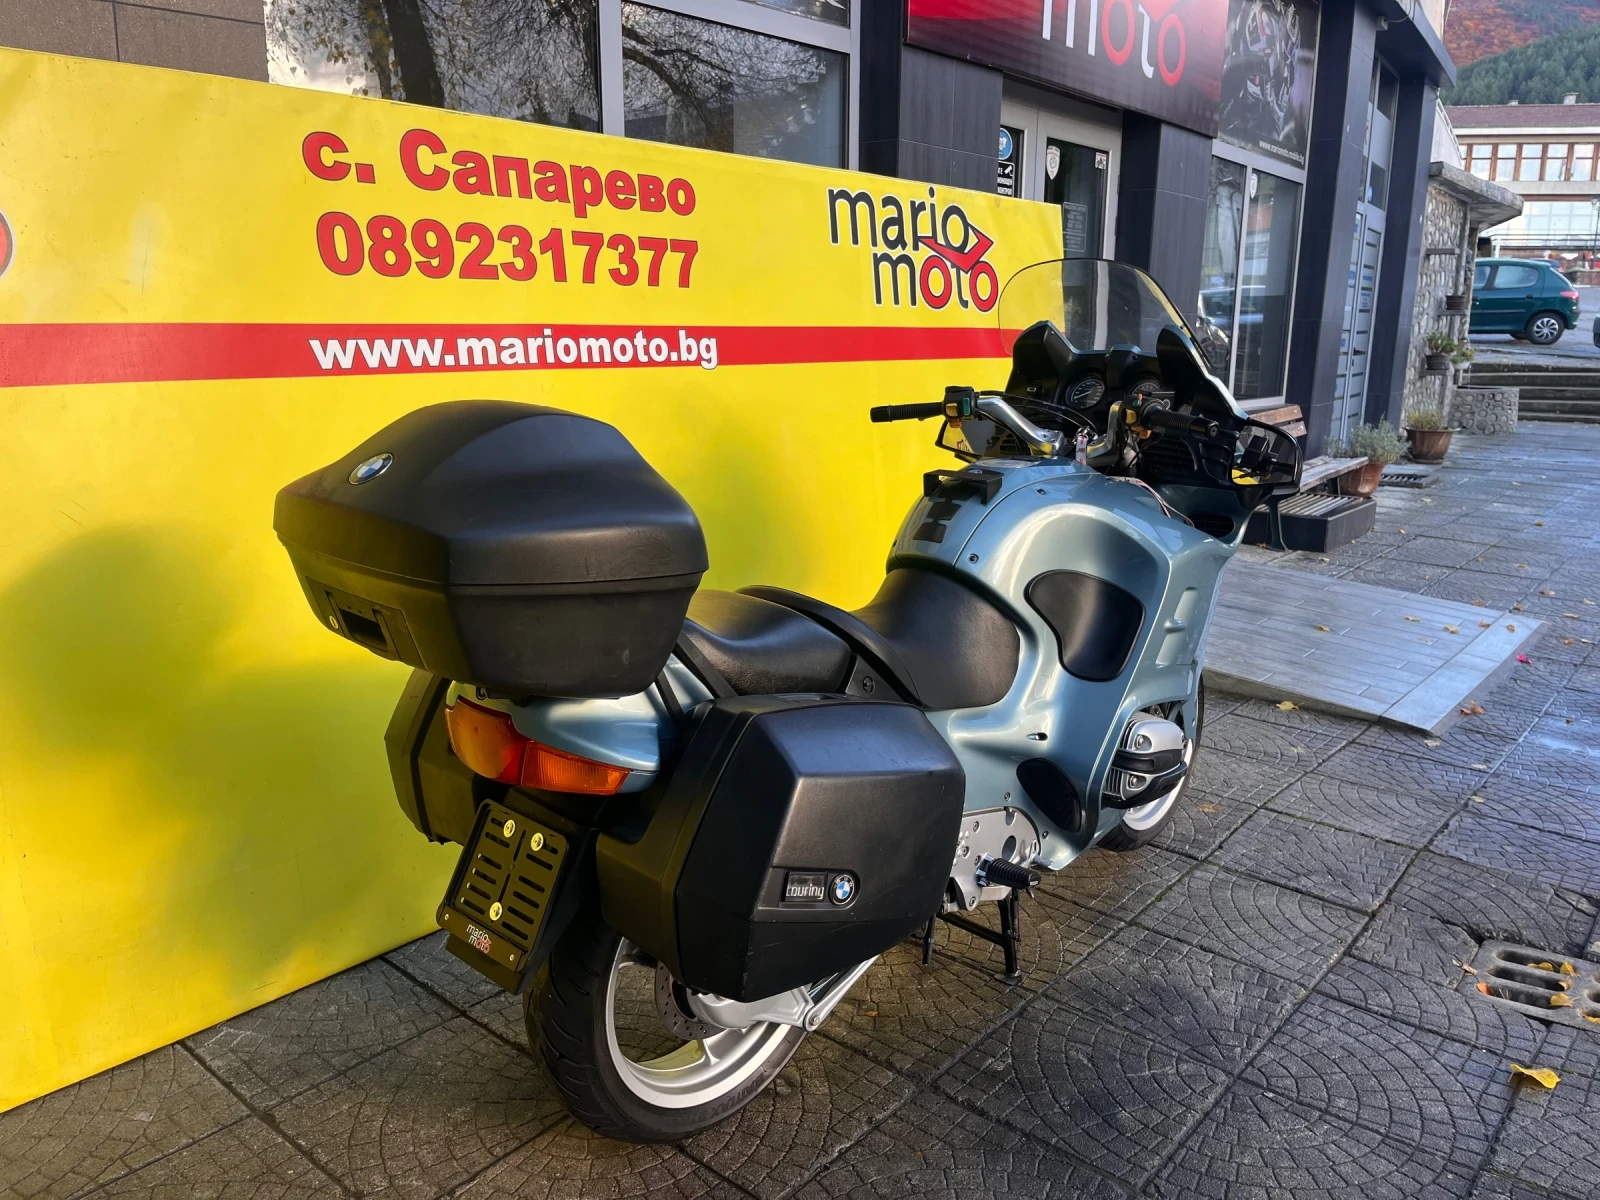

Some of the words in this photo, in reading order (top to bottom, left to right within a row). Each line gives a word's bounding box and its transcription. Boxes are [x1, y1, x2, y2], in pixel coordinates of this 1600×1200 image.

[302, 131, 376, 185] с.
[399, 128, 697, 219] Сапарево
[827, 186, 970, 252] mario
[316, 211, 699, 289] 0892317377
[872, 252, 999, 312] moto
[308, 328, 719, 370] www.mariomoto.bg
[785, 883, 825, 900] touring
[466, 923, 489, 943] mario
[468, 935, 491, 953] moto
